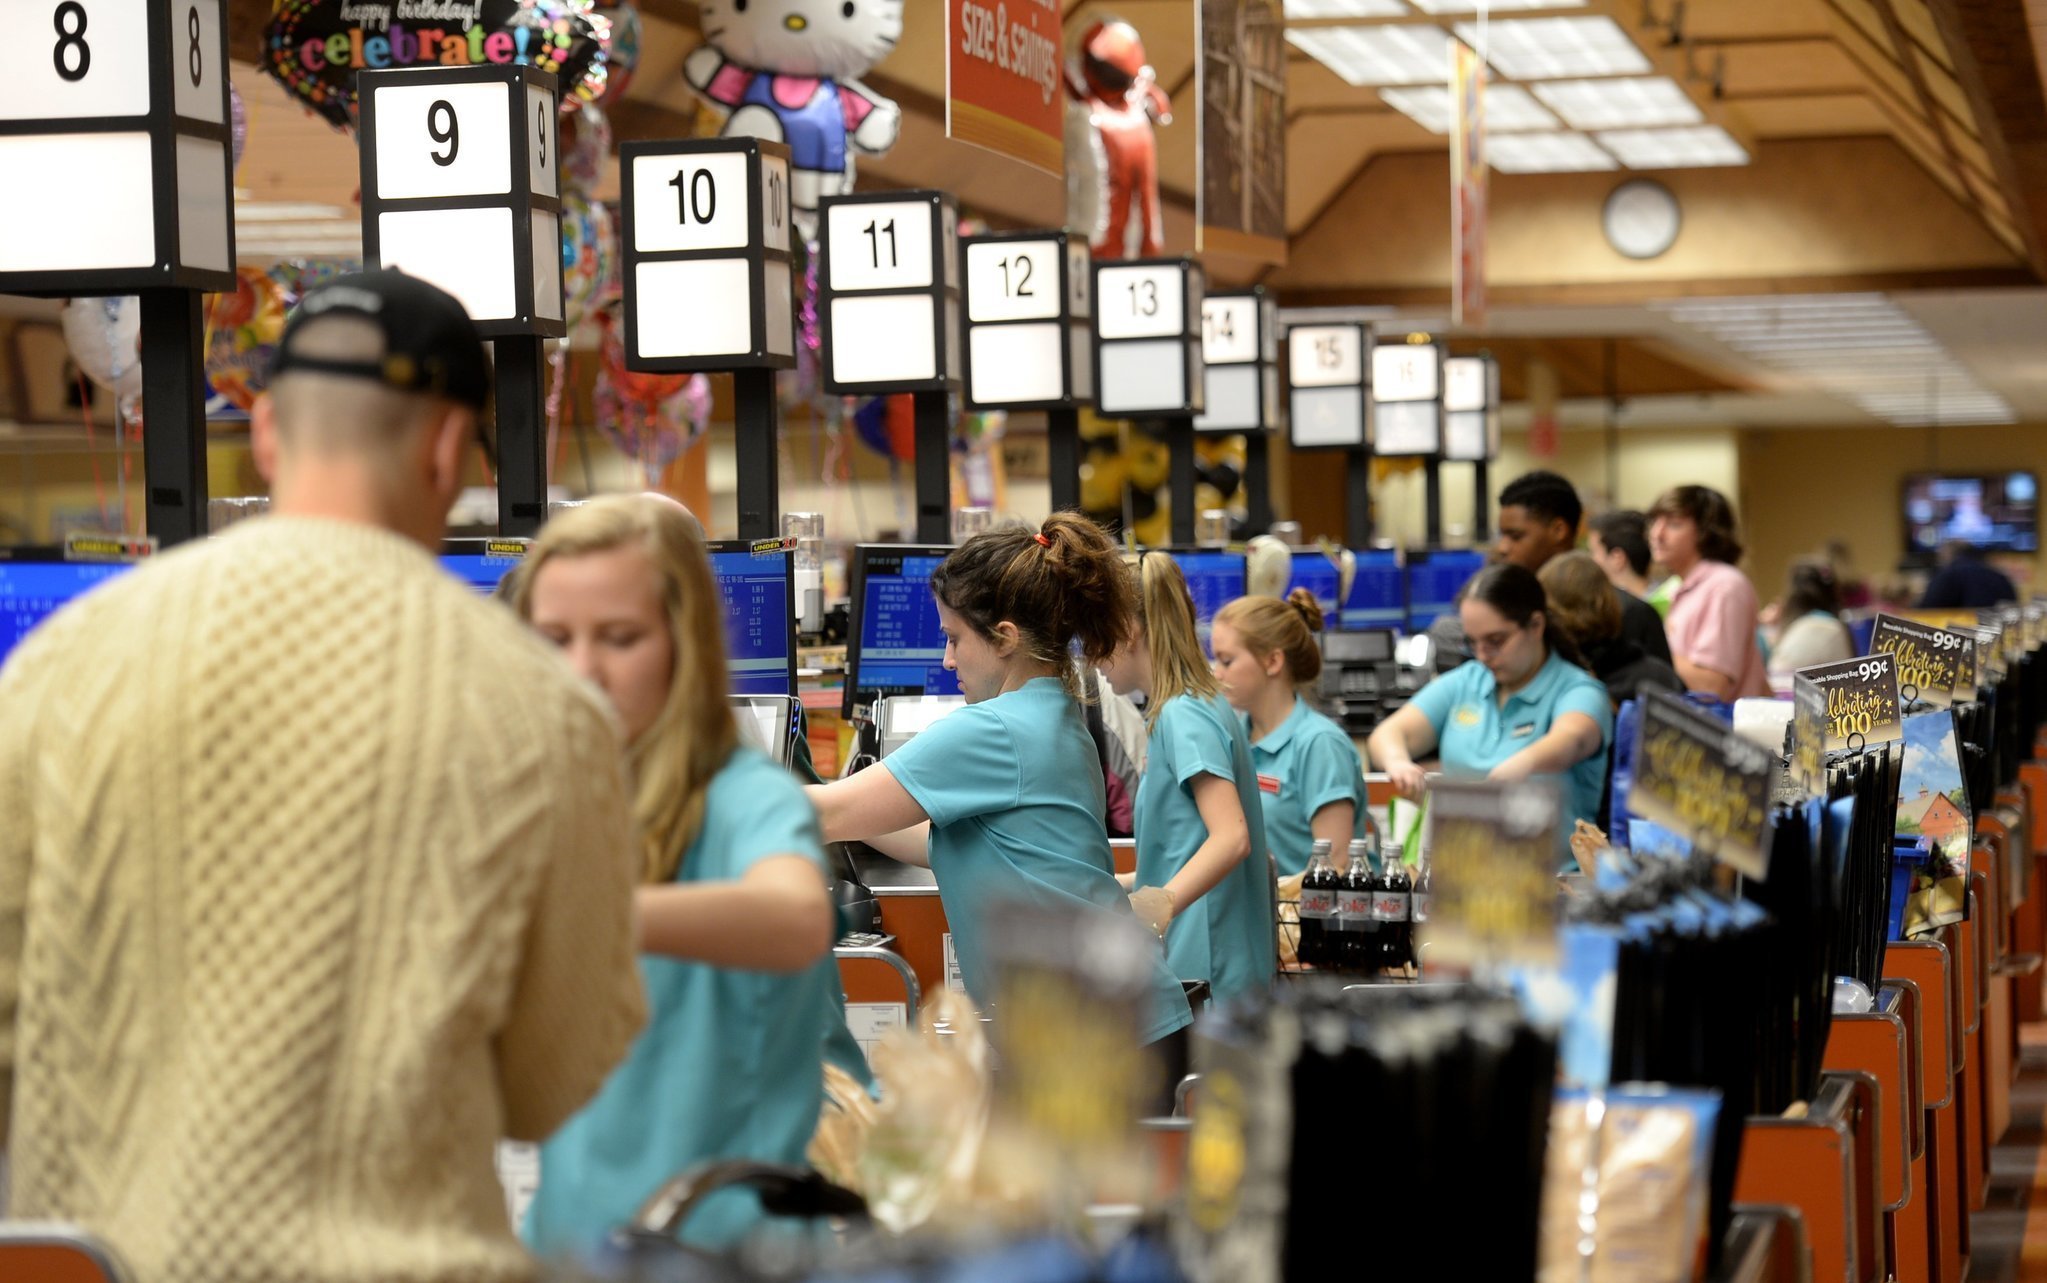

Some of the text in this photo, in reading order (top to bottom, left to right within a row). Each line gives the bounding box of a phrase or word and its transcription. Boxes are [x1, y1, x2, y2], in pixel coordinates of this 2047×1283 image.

[340, 0, 482, 32] happy birthday!
[53, 1, 91, 82] 8
[188, 6, 202, 88] 8
[301, 24, 532, 72] celebrate!
[962, 0, 1057, 106] size & savings
[427, 100, 459, 166] 9
[537, 101, 546, 168] 9
[668, 169, 716, 225] 10
[768, 170, 782, 228] 10
[863, 219, 897, 269] 11
[998, 255, 1033, 297] 12
[1127, 280, 1158, 317] 13
[1202, 310, 1235, 344] 14
[1315, 336, 1344, 370] 15
[490, 543, 524, 553] UNDER
[753, 542, 780, 552] UNDER
[1933, 631, 1961, 650] 99¢
[1858, 659, 1889, 682] 99¢
[1898, 665, 1932, 690] 100
[1833, 711, 1872, 739] 100
